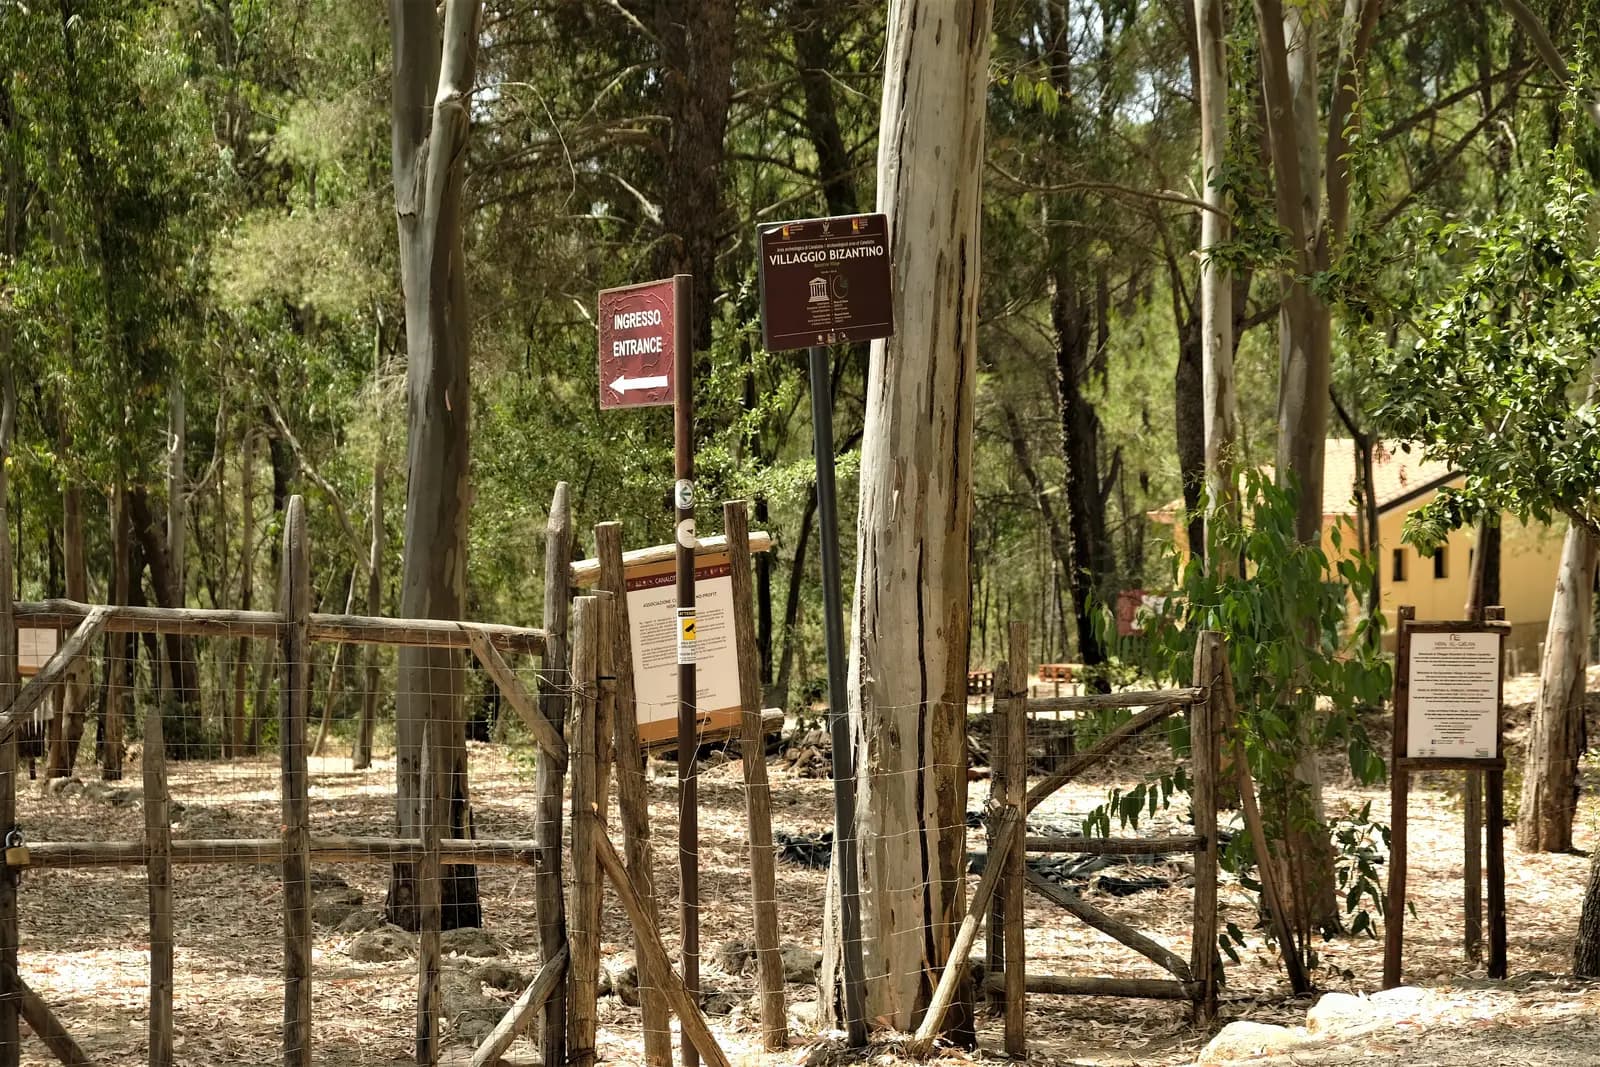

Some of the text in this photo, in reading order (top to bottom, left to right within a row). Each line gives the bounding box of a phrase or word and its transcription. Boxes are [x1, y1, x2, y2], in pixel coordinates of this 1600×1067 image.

[769, 251, 827, 265] VILLAGGIO
[829, 245, 884, 260] BIZANTINO
[614, 309, 662, 330] INGRESSO
[613, 337, 663, 357] ENTRANCE
[654, 575, 676, 584] CANALOT
